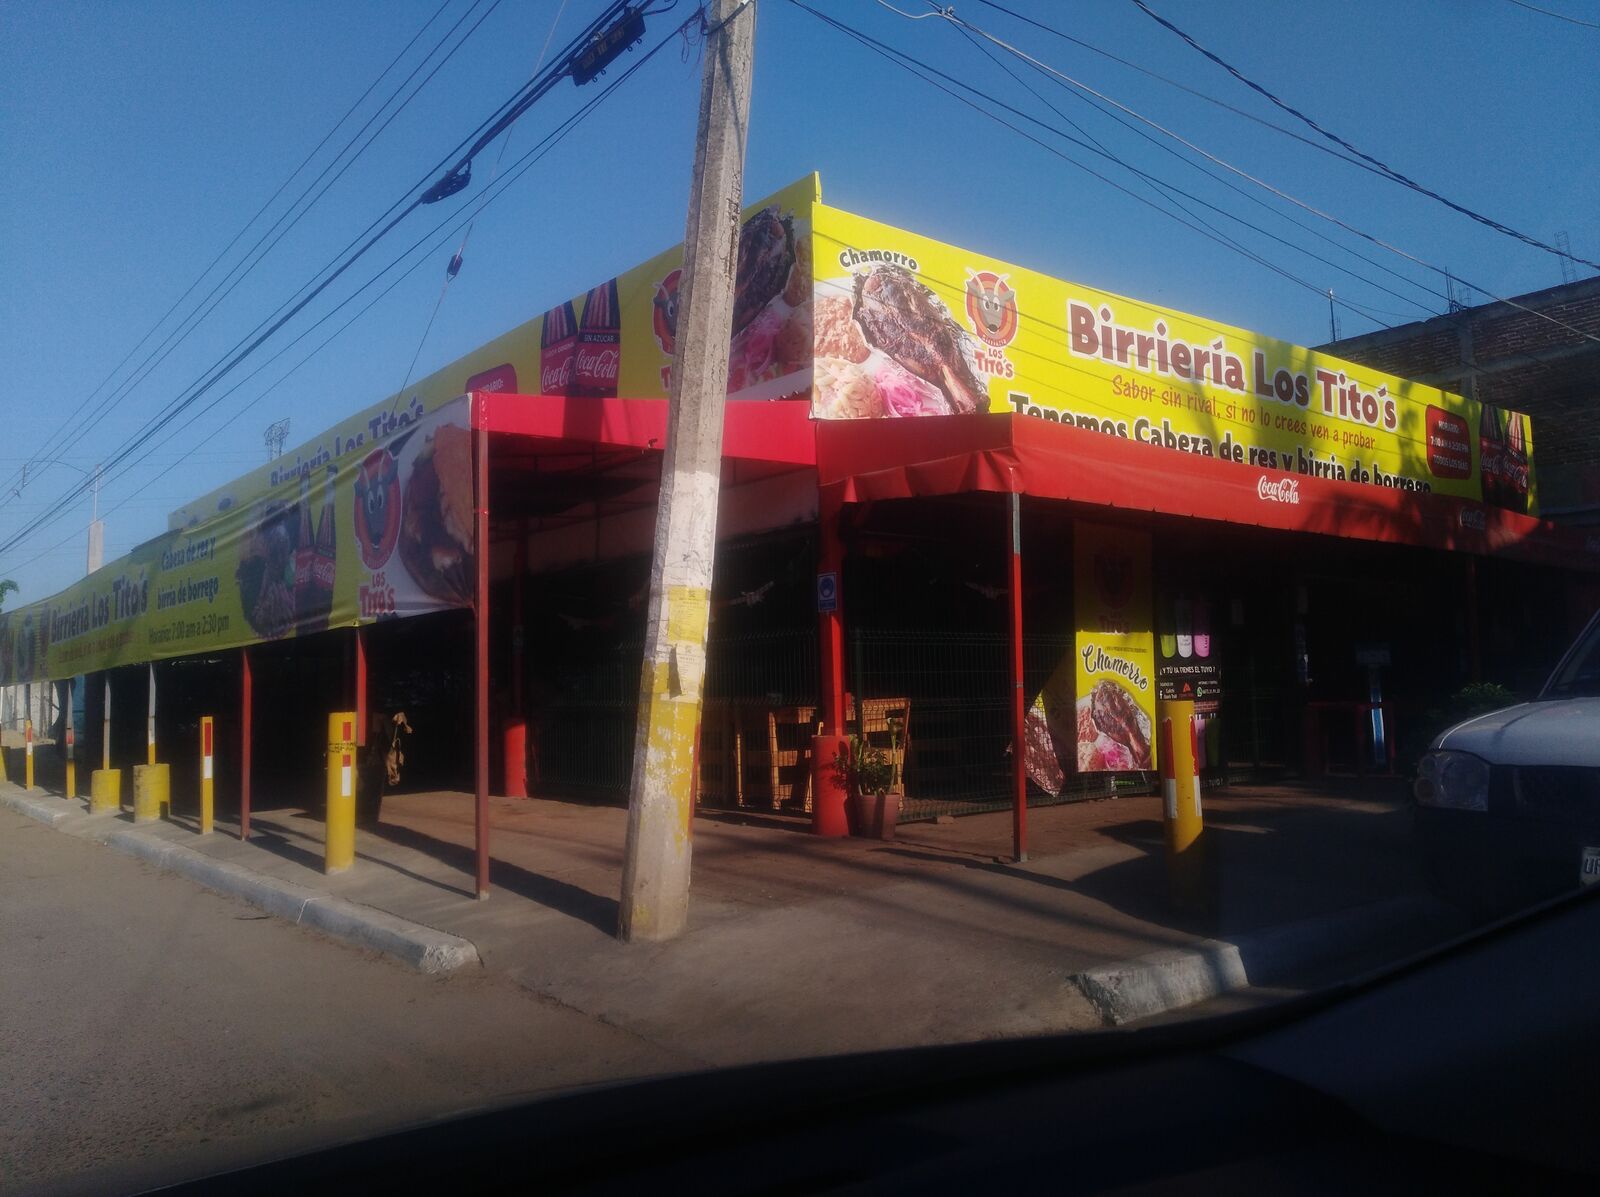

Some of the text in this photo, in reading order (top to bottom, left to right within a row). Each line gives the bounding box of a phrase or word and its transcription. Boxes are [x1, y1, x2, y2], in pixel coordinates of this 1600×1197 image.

[840, 248, 918, 271] Chamorro
[988, 348, 1003, 359] LOS
[1070, 303, 1245, 391] Birriería
[1254, 351, 1309, 406] Los
[1112, 374, 1376, 451] Sabor sin rival, si no lo crees ven a probar
[1134, 418, 1214, 457] Cabeza
[1219, 433, 1244, 463] de
[1249, 447, 1278, 469] res
[1298, 447, 1345, 480] birria
[1351, 460, 1370, 484] de
[188, 576, 219, 604] borrego
[372, 571, 386, 588] LOS
[92, 591, 110, 628] Los
[1082, 645, 1148, 690] Chamorro
